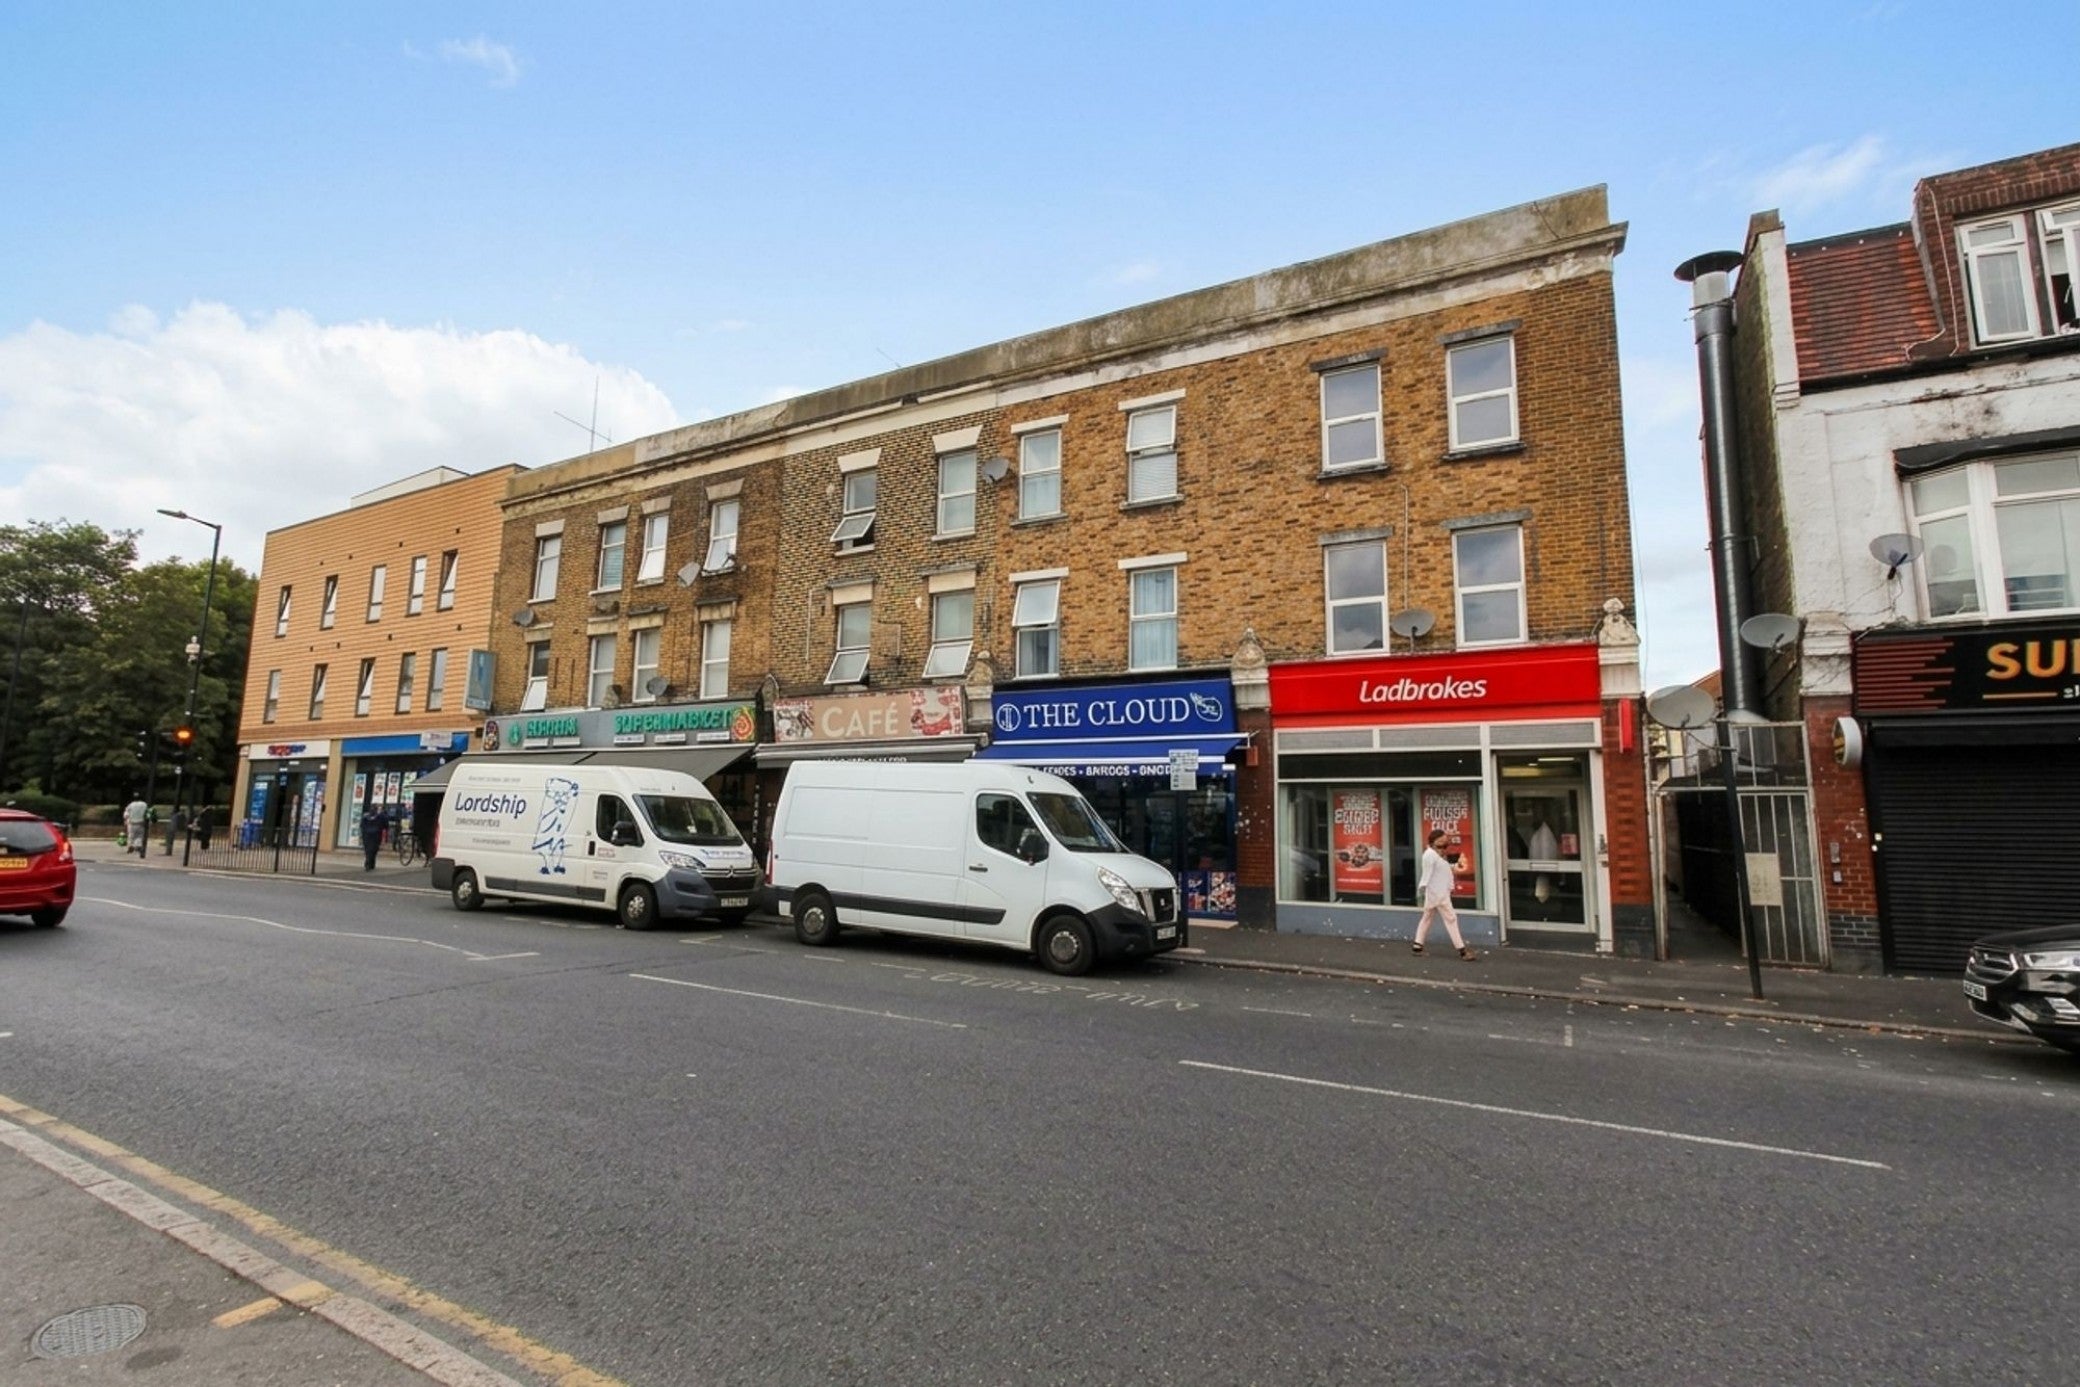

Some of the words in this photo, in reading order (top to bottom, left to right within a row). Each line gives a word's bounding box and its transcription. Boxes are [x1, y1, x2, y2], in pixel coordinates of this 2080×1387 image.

[1360, 676, 1487, 703] Ladbrokes
[821, 702, 899, 738] CAFÉ
[1023, 703, 1081, 728] THE
[1088, 697, 1190, 726] CLOUD
[455, 792, 526, 819] Lordship
